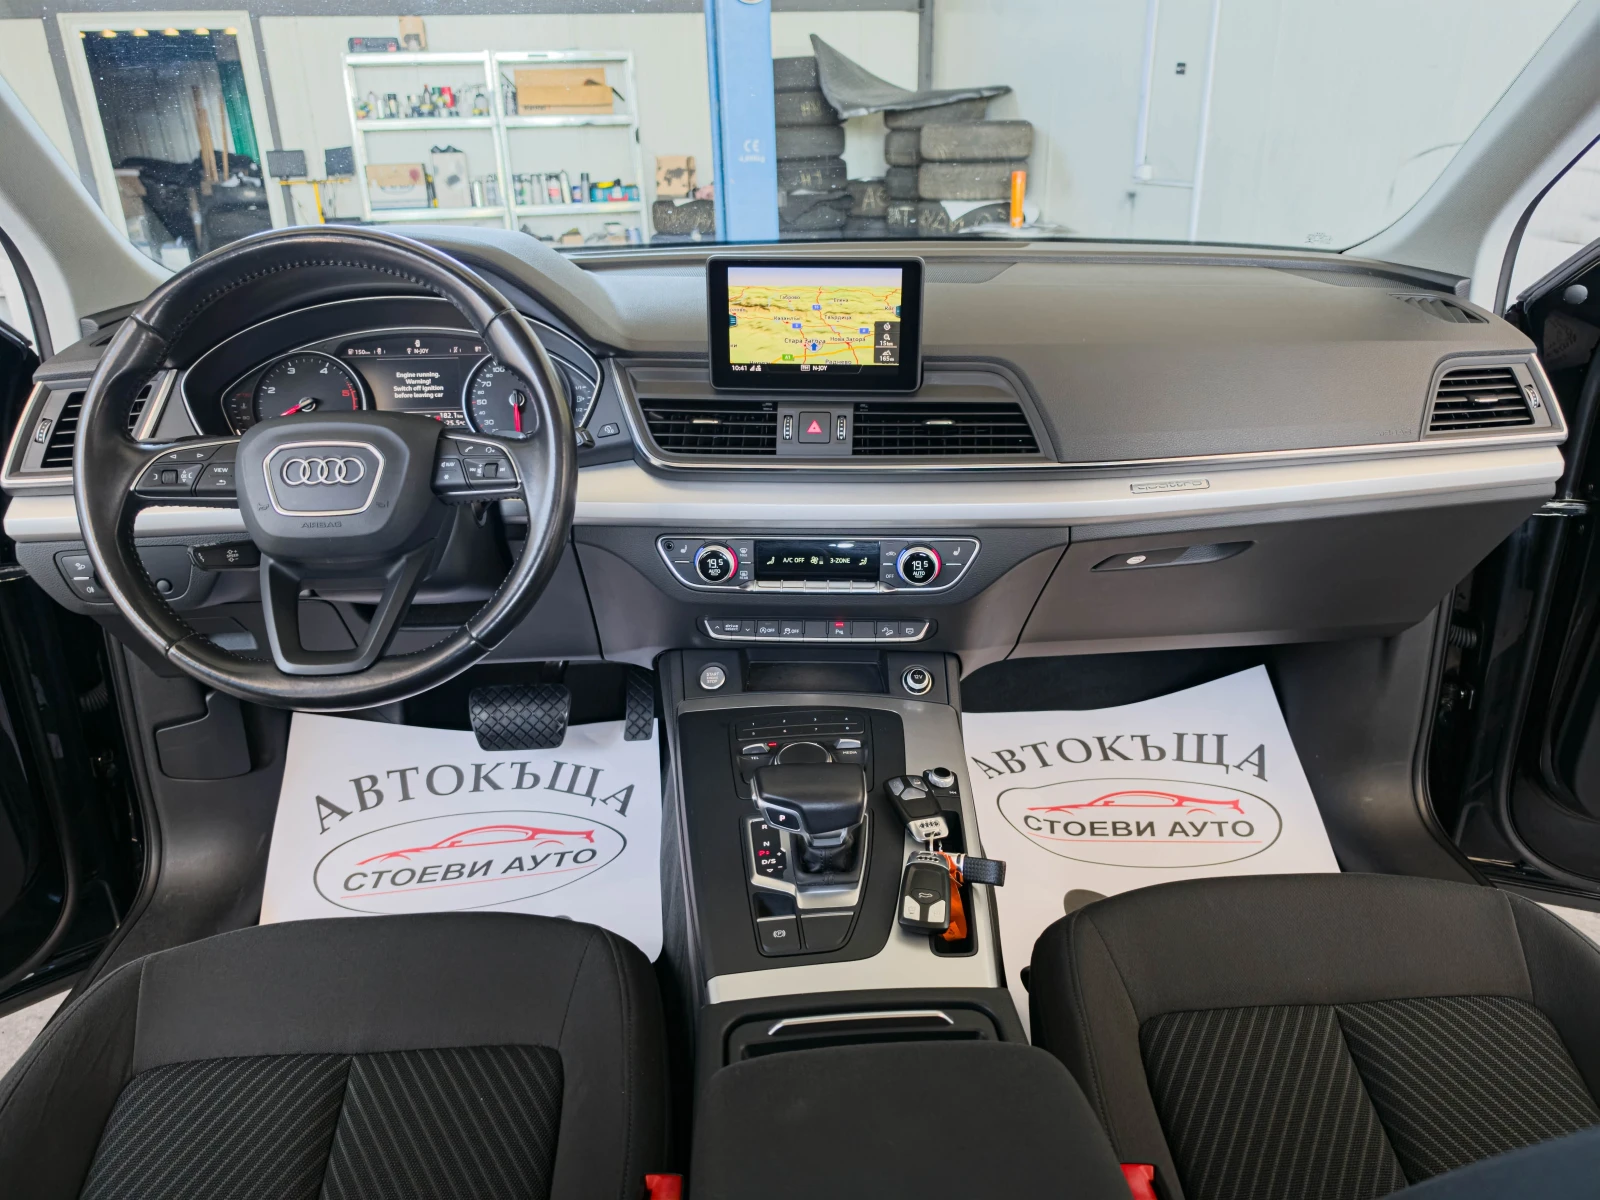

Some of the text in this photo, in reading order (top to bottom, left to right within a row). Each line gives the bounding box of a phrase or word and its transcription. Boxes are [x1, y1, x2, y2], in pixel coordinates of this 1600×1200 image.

[706, 558, 724, 568] 19.5
[912, 560, 928, 570] 19.5
[970, 732, 1269, 782] АВТОКЪЩА
[316, 760, 636, 835] АВТОКЪЩА
[1023, 813, 1255, 838] СТОЕВИ АУТО
[343, 847, 598, 892] СТОЕВИ АУТО
